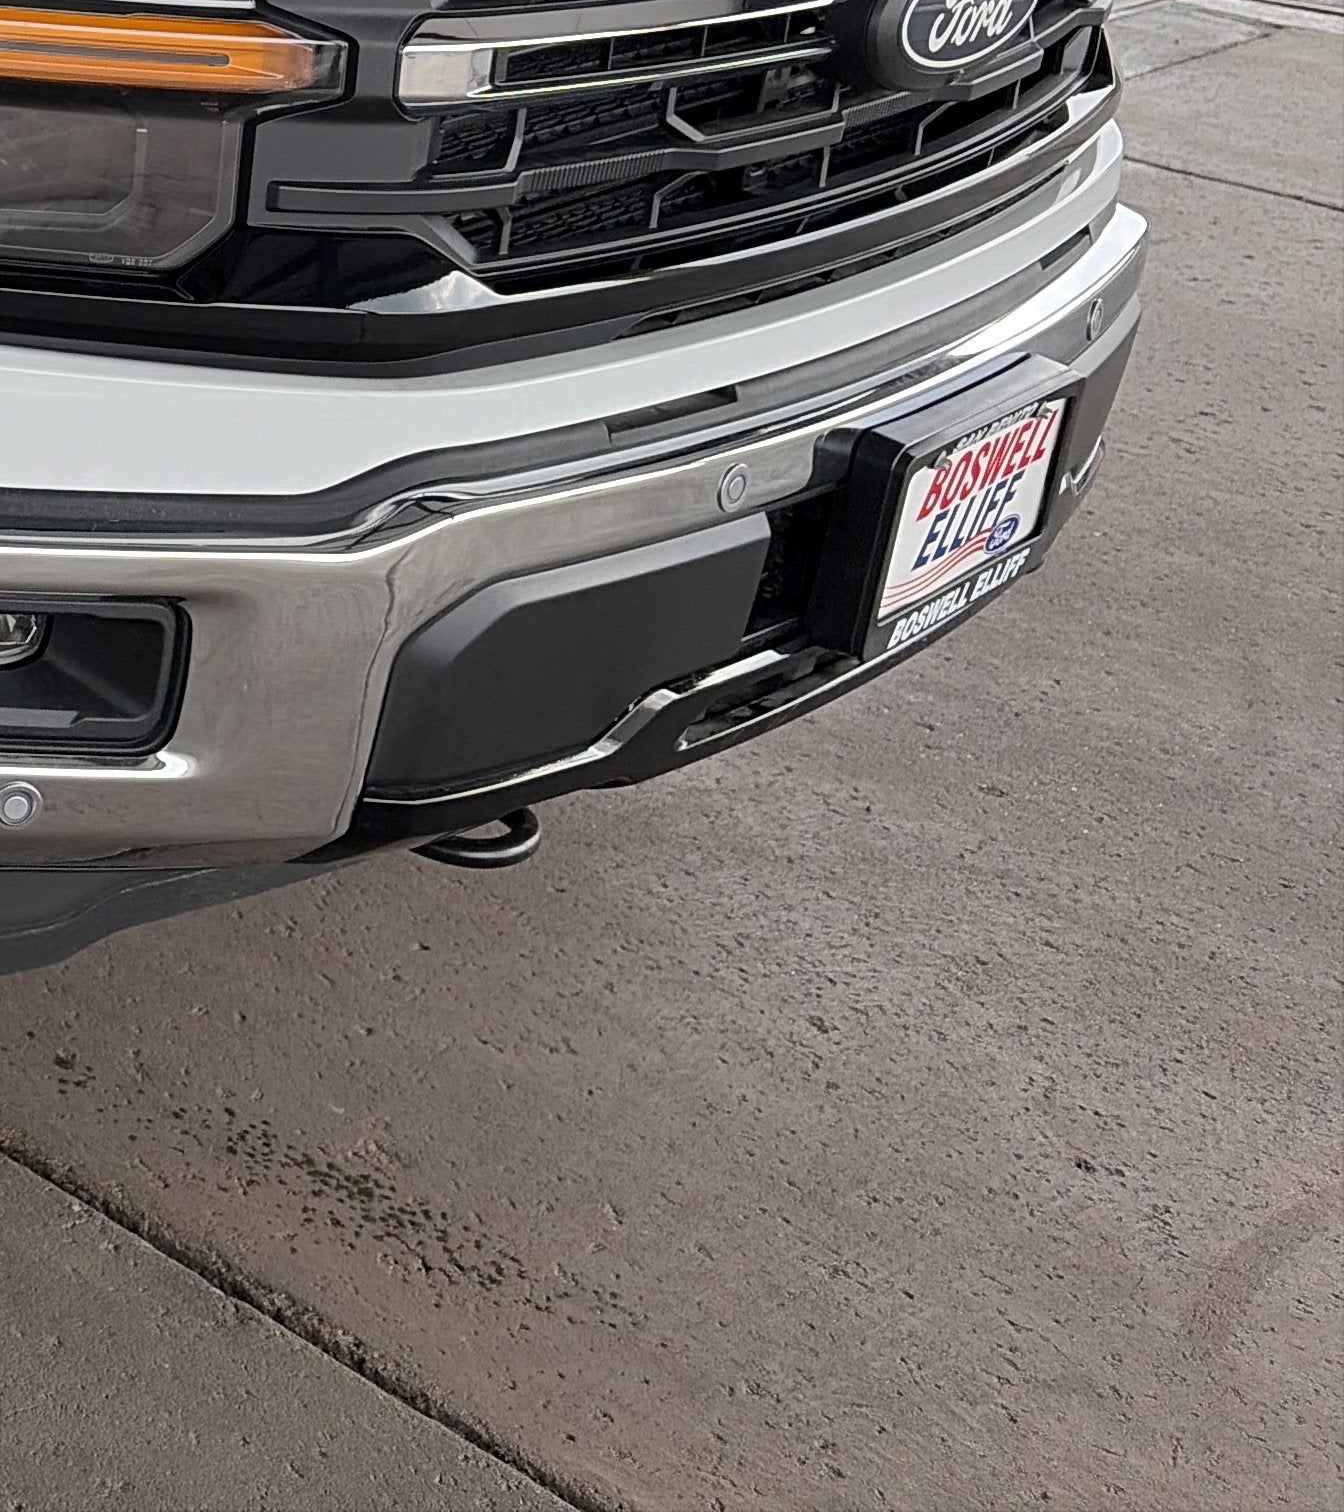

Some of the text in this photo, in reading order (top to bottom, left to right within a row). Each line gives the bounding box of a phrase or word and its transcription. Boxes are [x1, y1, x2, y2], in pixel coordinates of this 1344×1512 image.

[915, 410, 1059, 521] BOSWELL
[910, 470, 1026, 572] ELLIFF
[988, 520, 1015, 550] Ford
[886, 548, 1032, 650] BOSWELL ELLIFF
